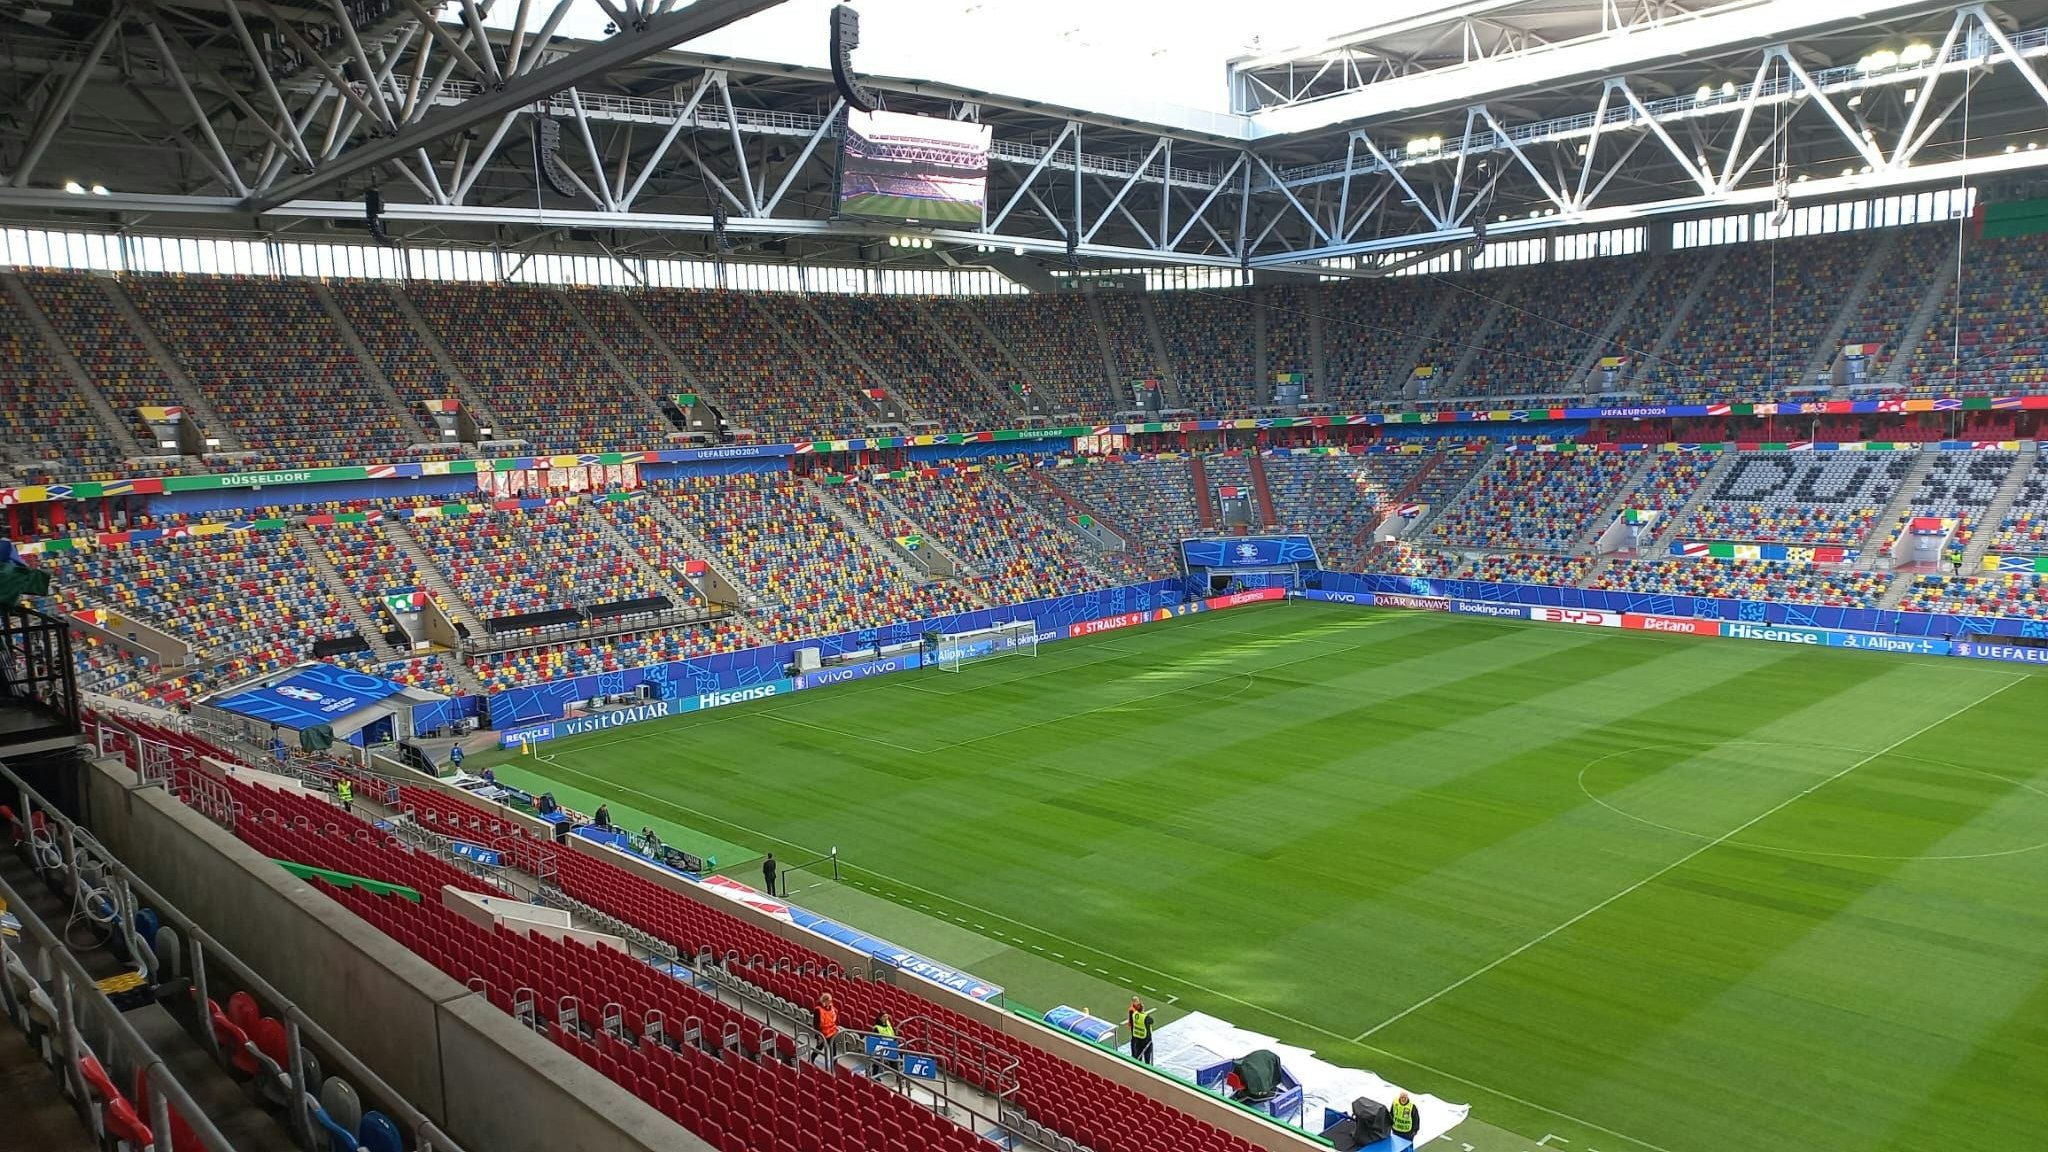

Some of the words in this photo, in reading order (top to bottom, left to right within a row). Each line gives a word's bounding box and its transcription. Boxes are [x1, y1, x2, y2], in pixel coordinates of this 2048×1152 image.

[221, 472, 312, 486] DÜSSELDORF
[1325, 591, 1356, 603] vivo
[1375, 596, 1406, 607] QATAR
[1409, 597, 1449, 611] AIRWAYS
[1459, 602, 1521, 617] Booking.com
[1545, 609, 1603, 625] BYD
[1086, 615, 1127, 633] STRAUSS
[1644, 617, 1695, 634] Betano
[1007, 630, 1057, 648] Booking.com
[1728, 623, 1818, 644] Hisense
[818, 669, 853, 684] vivo
[861, 661, 896, 676] vivo
[699, 684, 776, 710] Hisense
[506, 728, 550, 743] RECYCLE
[891, 954, 969, 990] AUSTRIA
